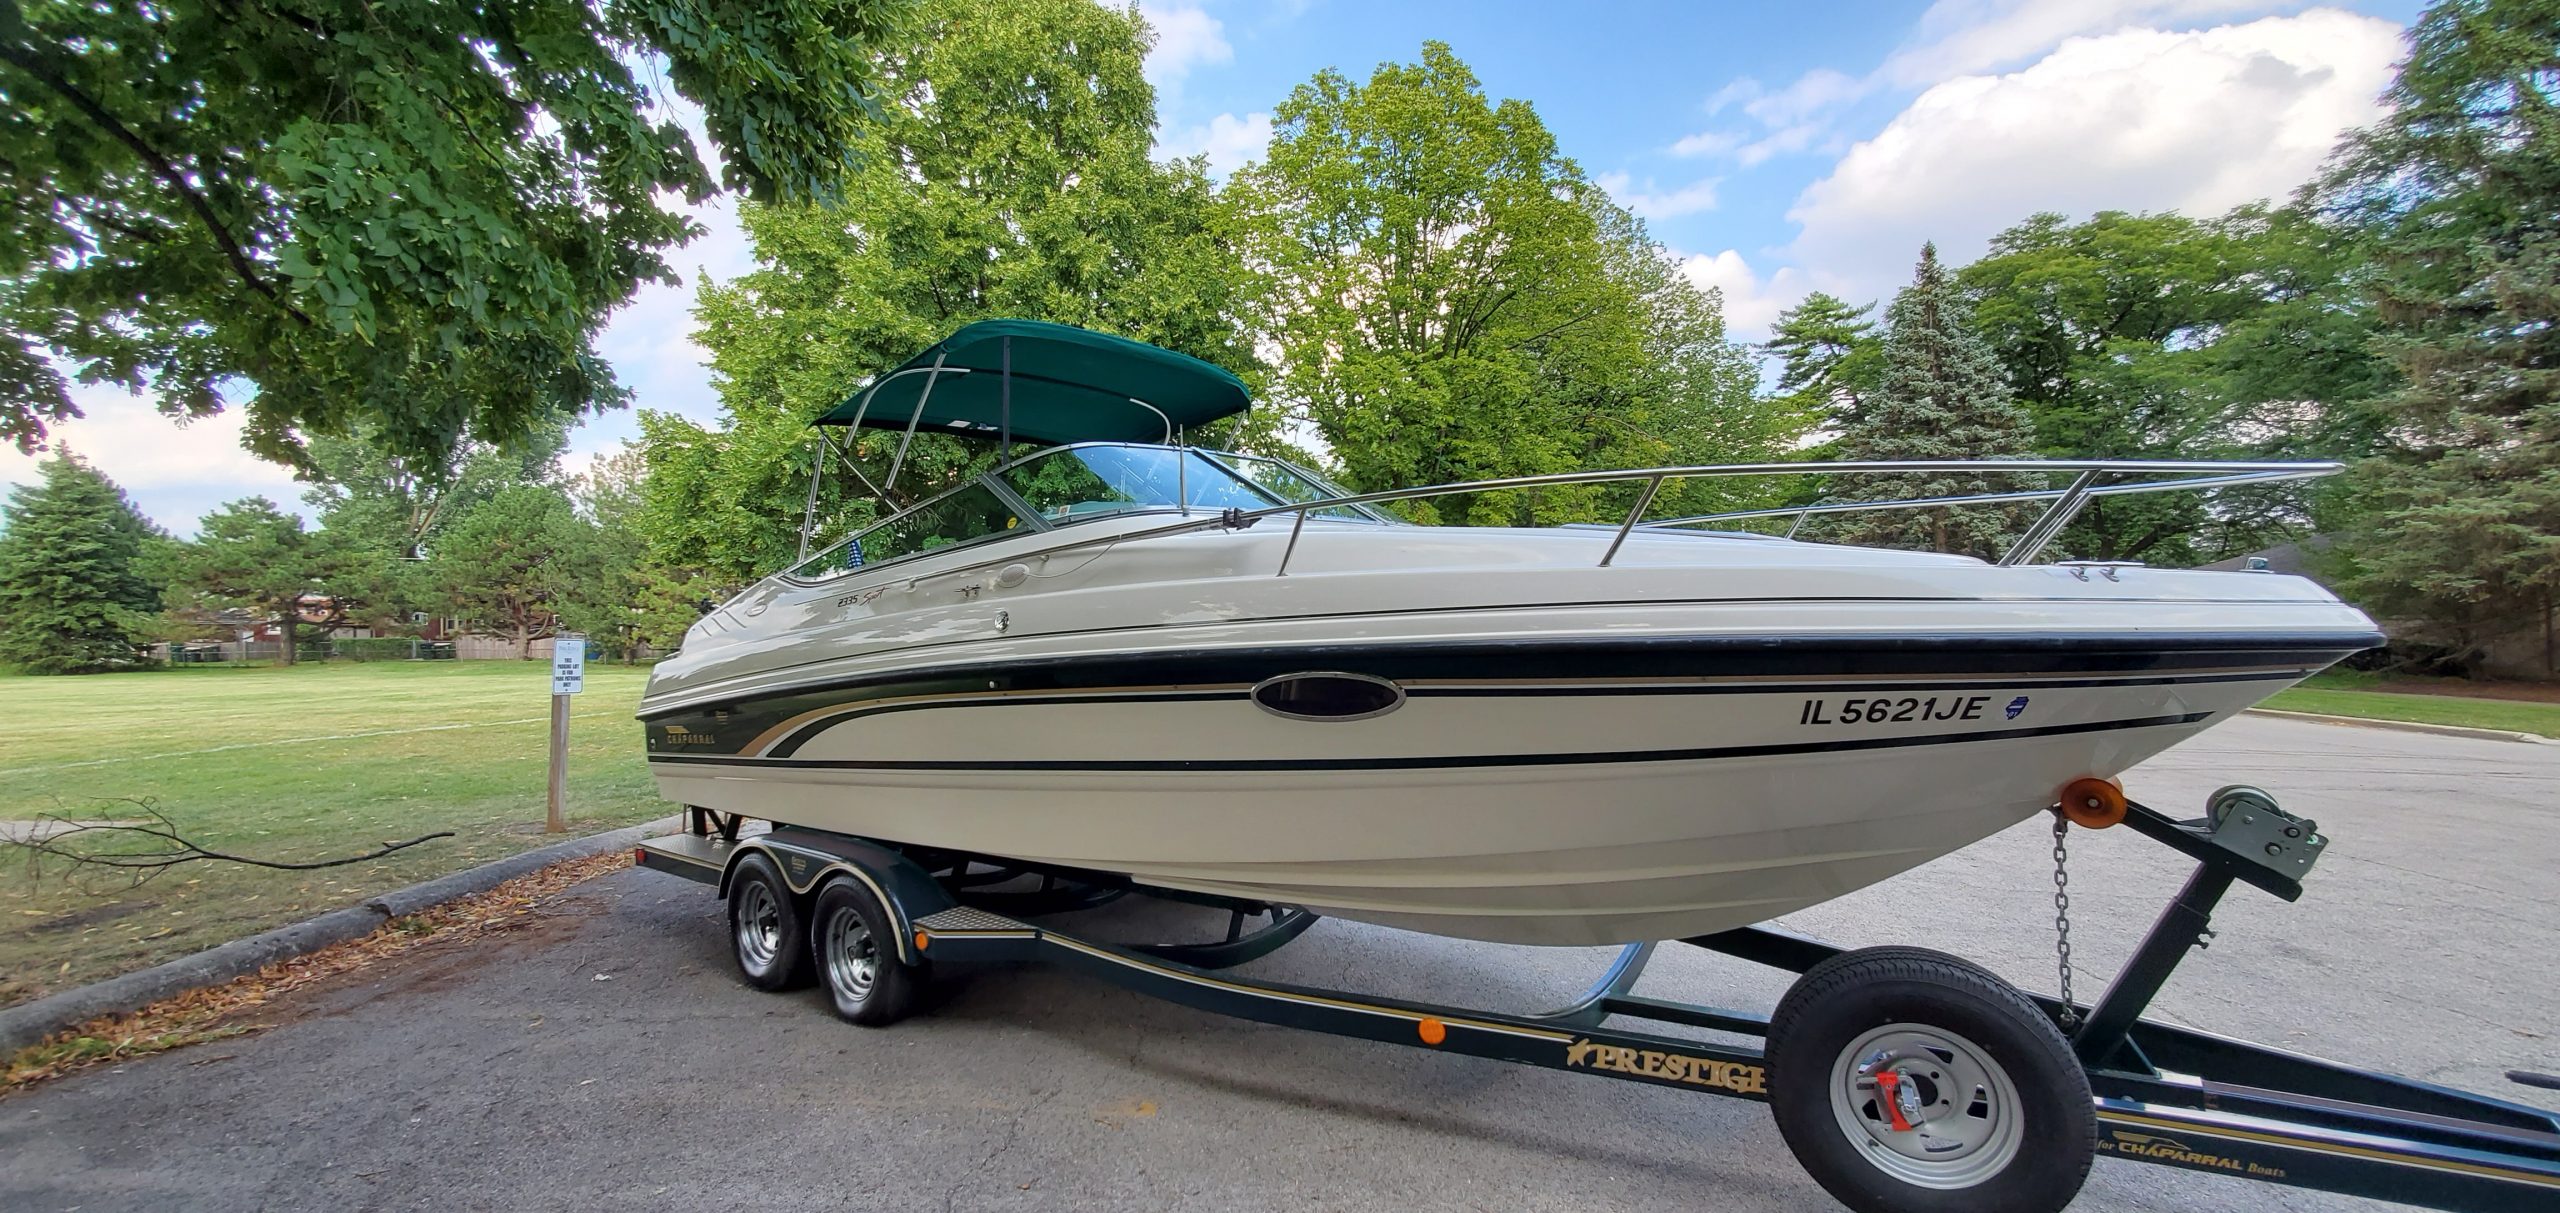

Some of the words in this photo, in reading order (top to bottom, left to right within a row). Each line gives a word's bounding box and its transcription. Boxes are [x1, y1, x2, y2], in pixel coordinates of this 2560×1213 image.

[838, 594, 859, 607] 2335
[859, 586, 890, 606] Sport
[1800, 700, 1832, 724] IL
[1839, 696, 1991, 724] 5621JE
[1590, 1043, 1768, 1094] PRESTIGE
[2096, 1139, 2115, 1151] for
[2118, 1142, 2244, 1171] CHAPARRAL
[2247, 1163, 2286, 1178] Boats
